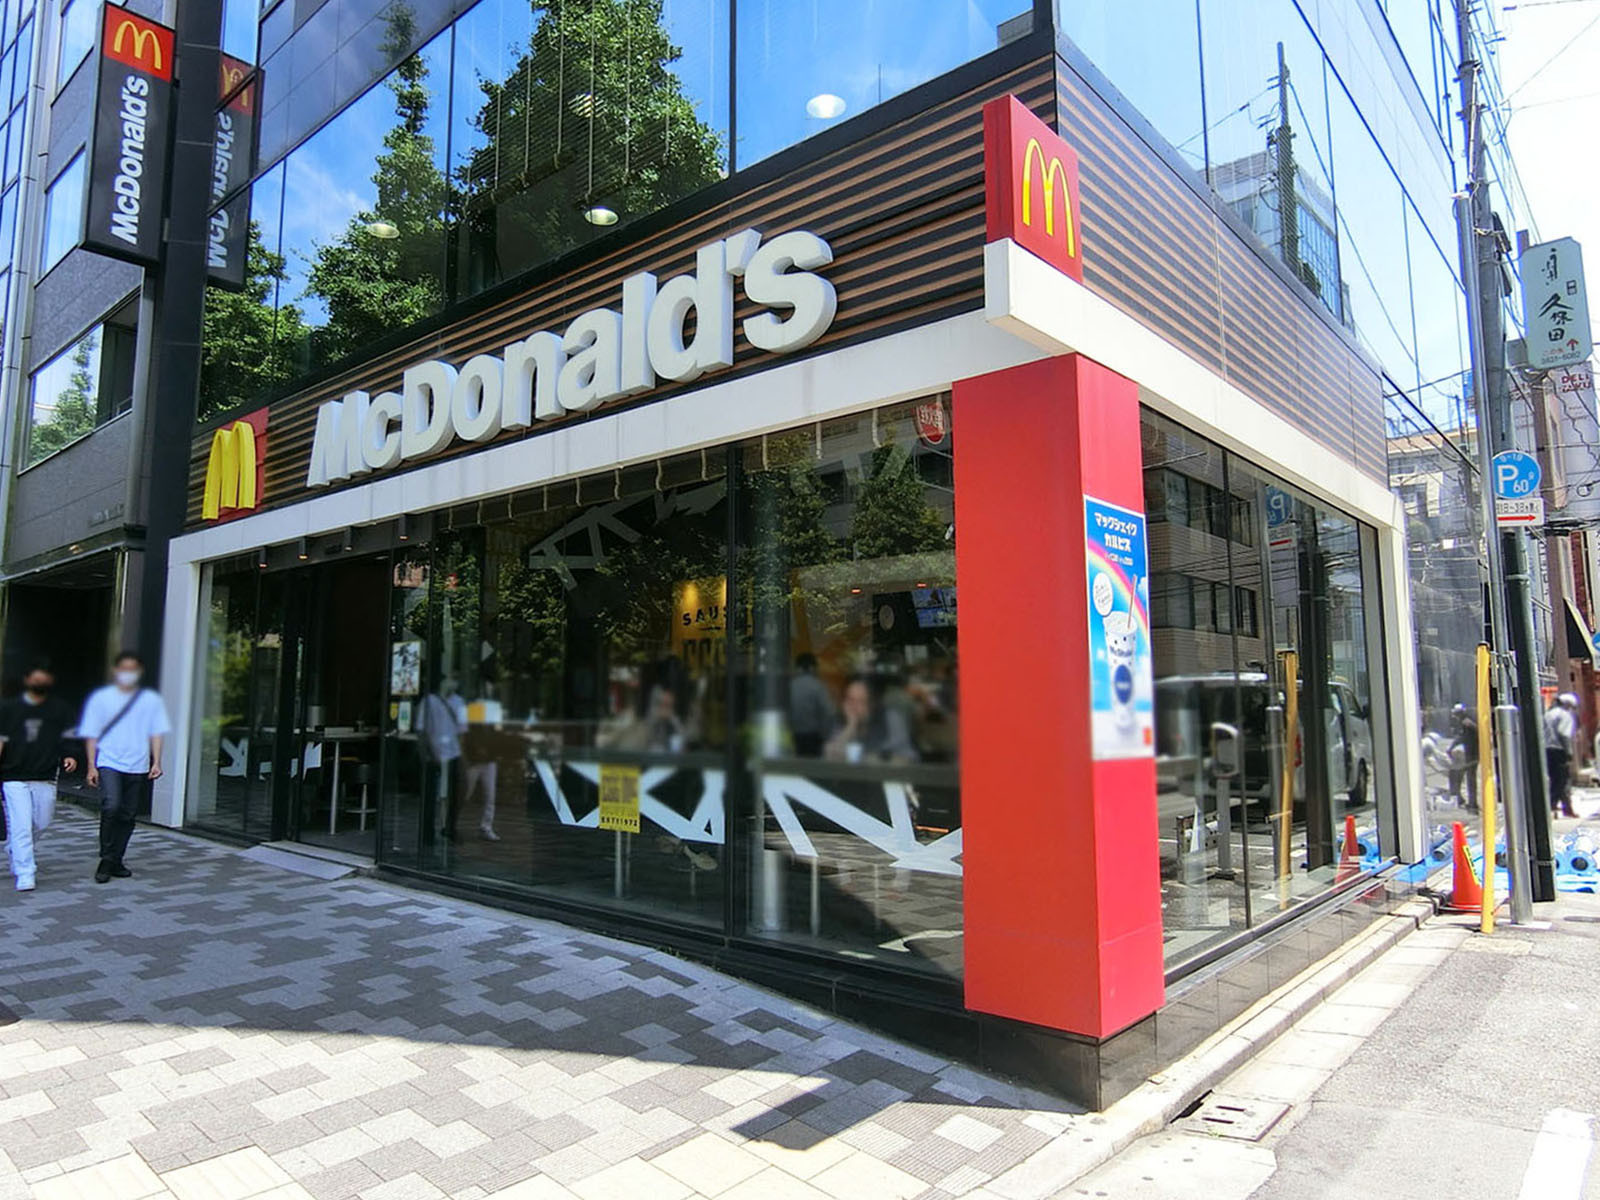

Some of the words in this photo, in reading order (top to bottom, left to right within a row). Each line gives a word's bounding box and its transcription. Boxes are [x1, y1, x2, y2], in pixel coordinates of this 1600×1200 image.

[111, 75, 149, 246] McDonald's
[306, 228, 837, 489] McDonald's
[1497, 464, 1519, 494] P
[1513, 479, 1529, 493] 60
